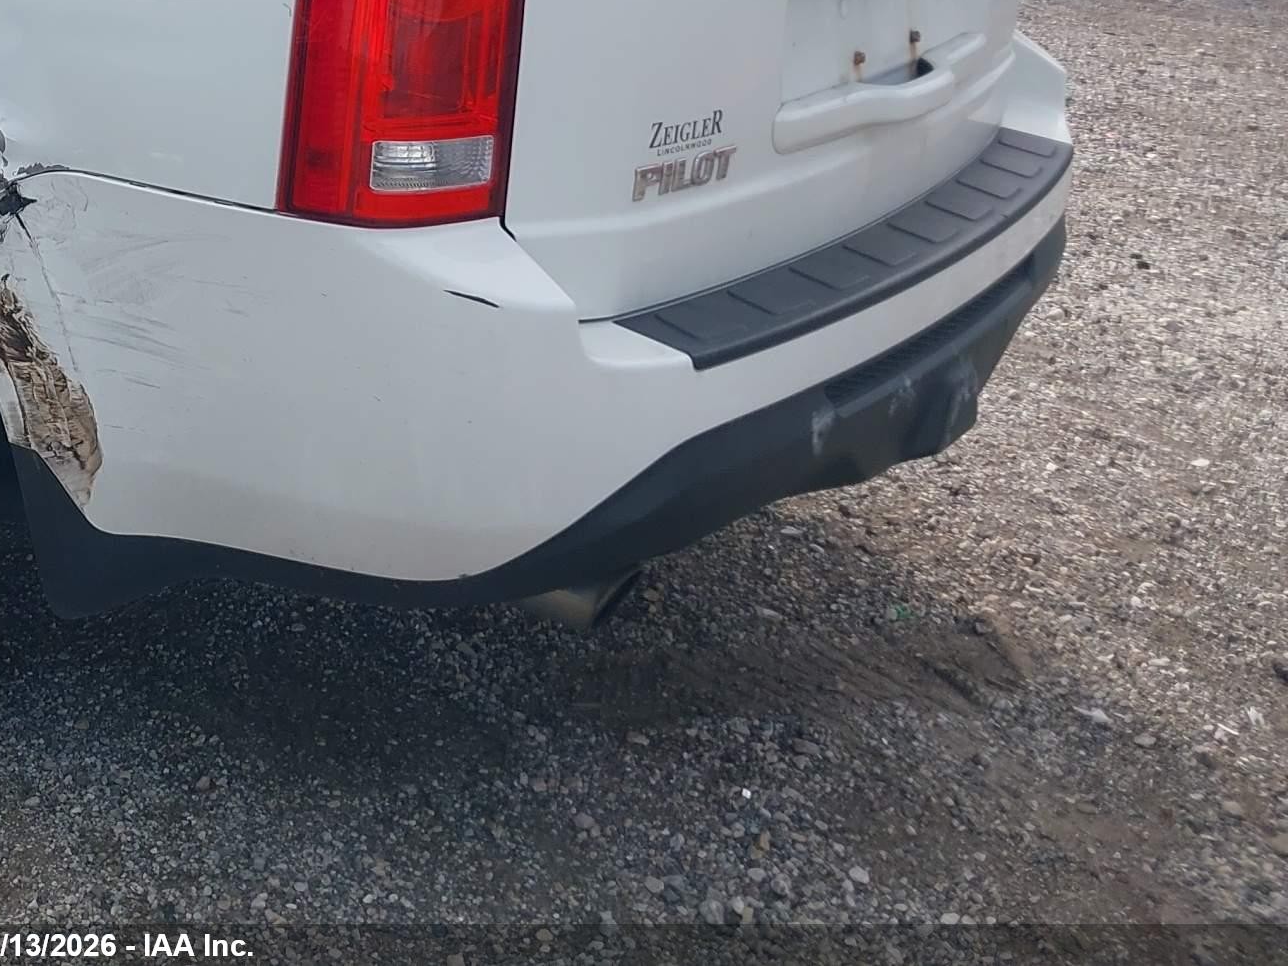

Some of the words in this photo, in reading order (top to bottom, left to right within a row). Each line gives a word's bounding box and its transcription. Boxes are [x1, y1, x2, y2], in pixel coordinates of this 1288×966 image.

[650, 109, 723, 148] ZEIGLER
[657, 139, 712, 156] LINCOLNWOOD
[633, 146, 736, 201] PILOT
